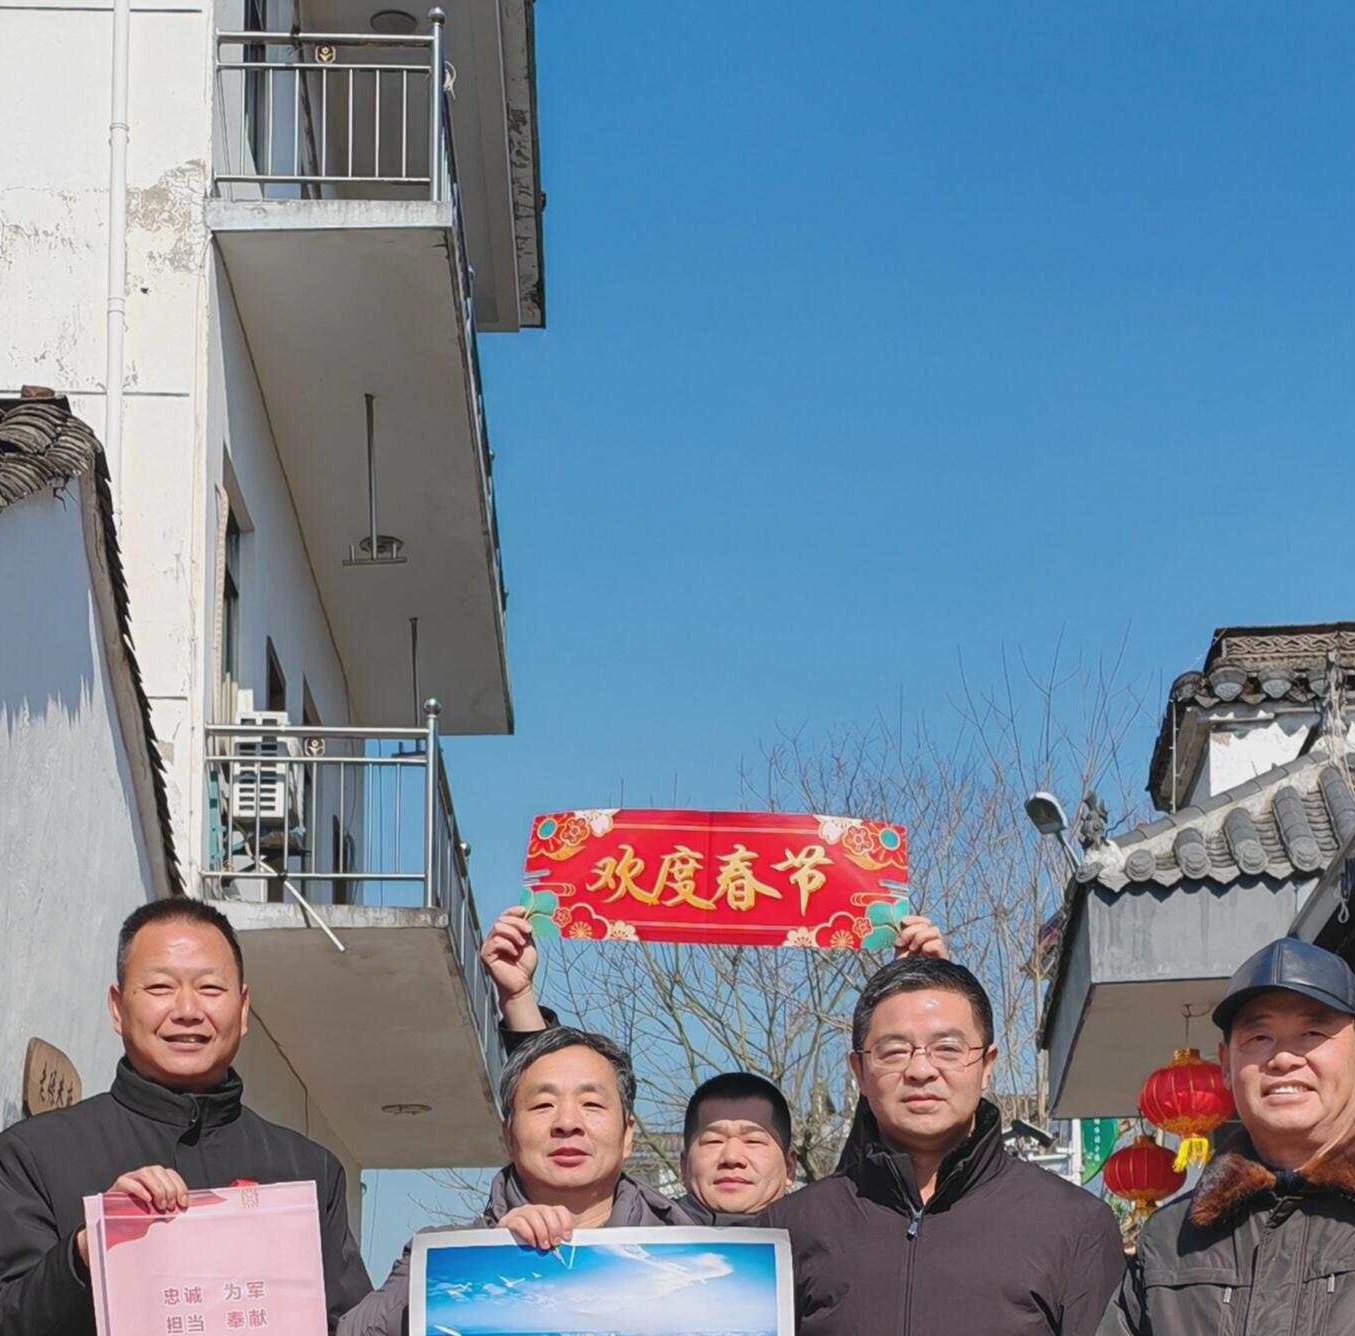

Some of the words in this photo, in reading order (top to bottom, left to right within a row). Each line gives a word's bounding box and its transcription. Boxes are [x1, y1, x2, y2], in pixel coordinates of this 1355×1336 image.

[585, 844, 834, 917] 欢度春节
[164, 1286, 203, 1305] 忠诚
[224, 1281, 265, 1300] 为军
[166, 1314, 204, 1334] 担当
[227, 1308, 268, 1328] 奉献
